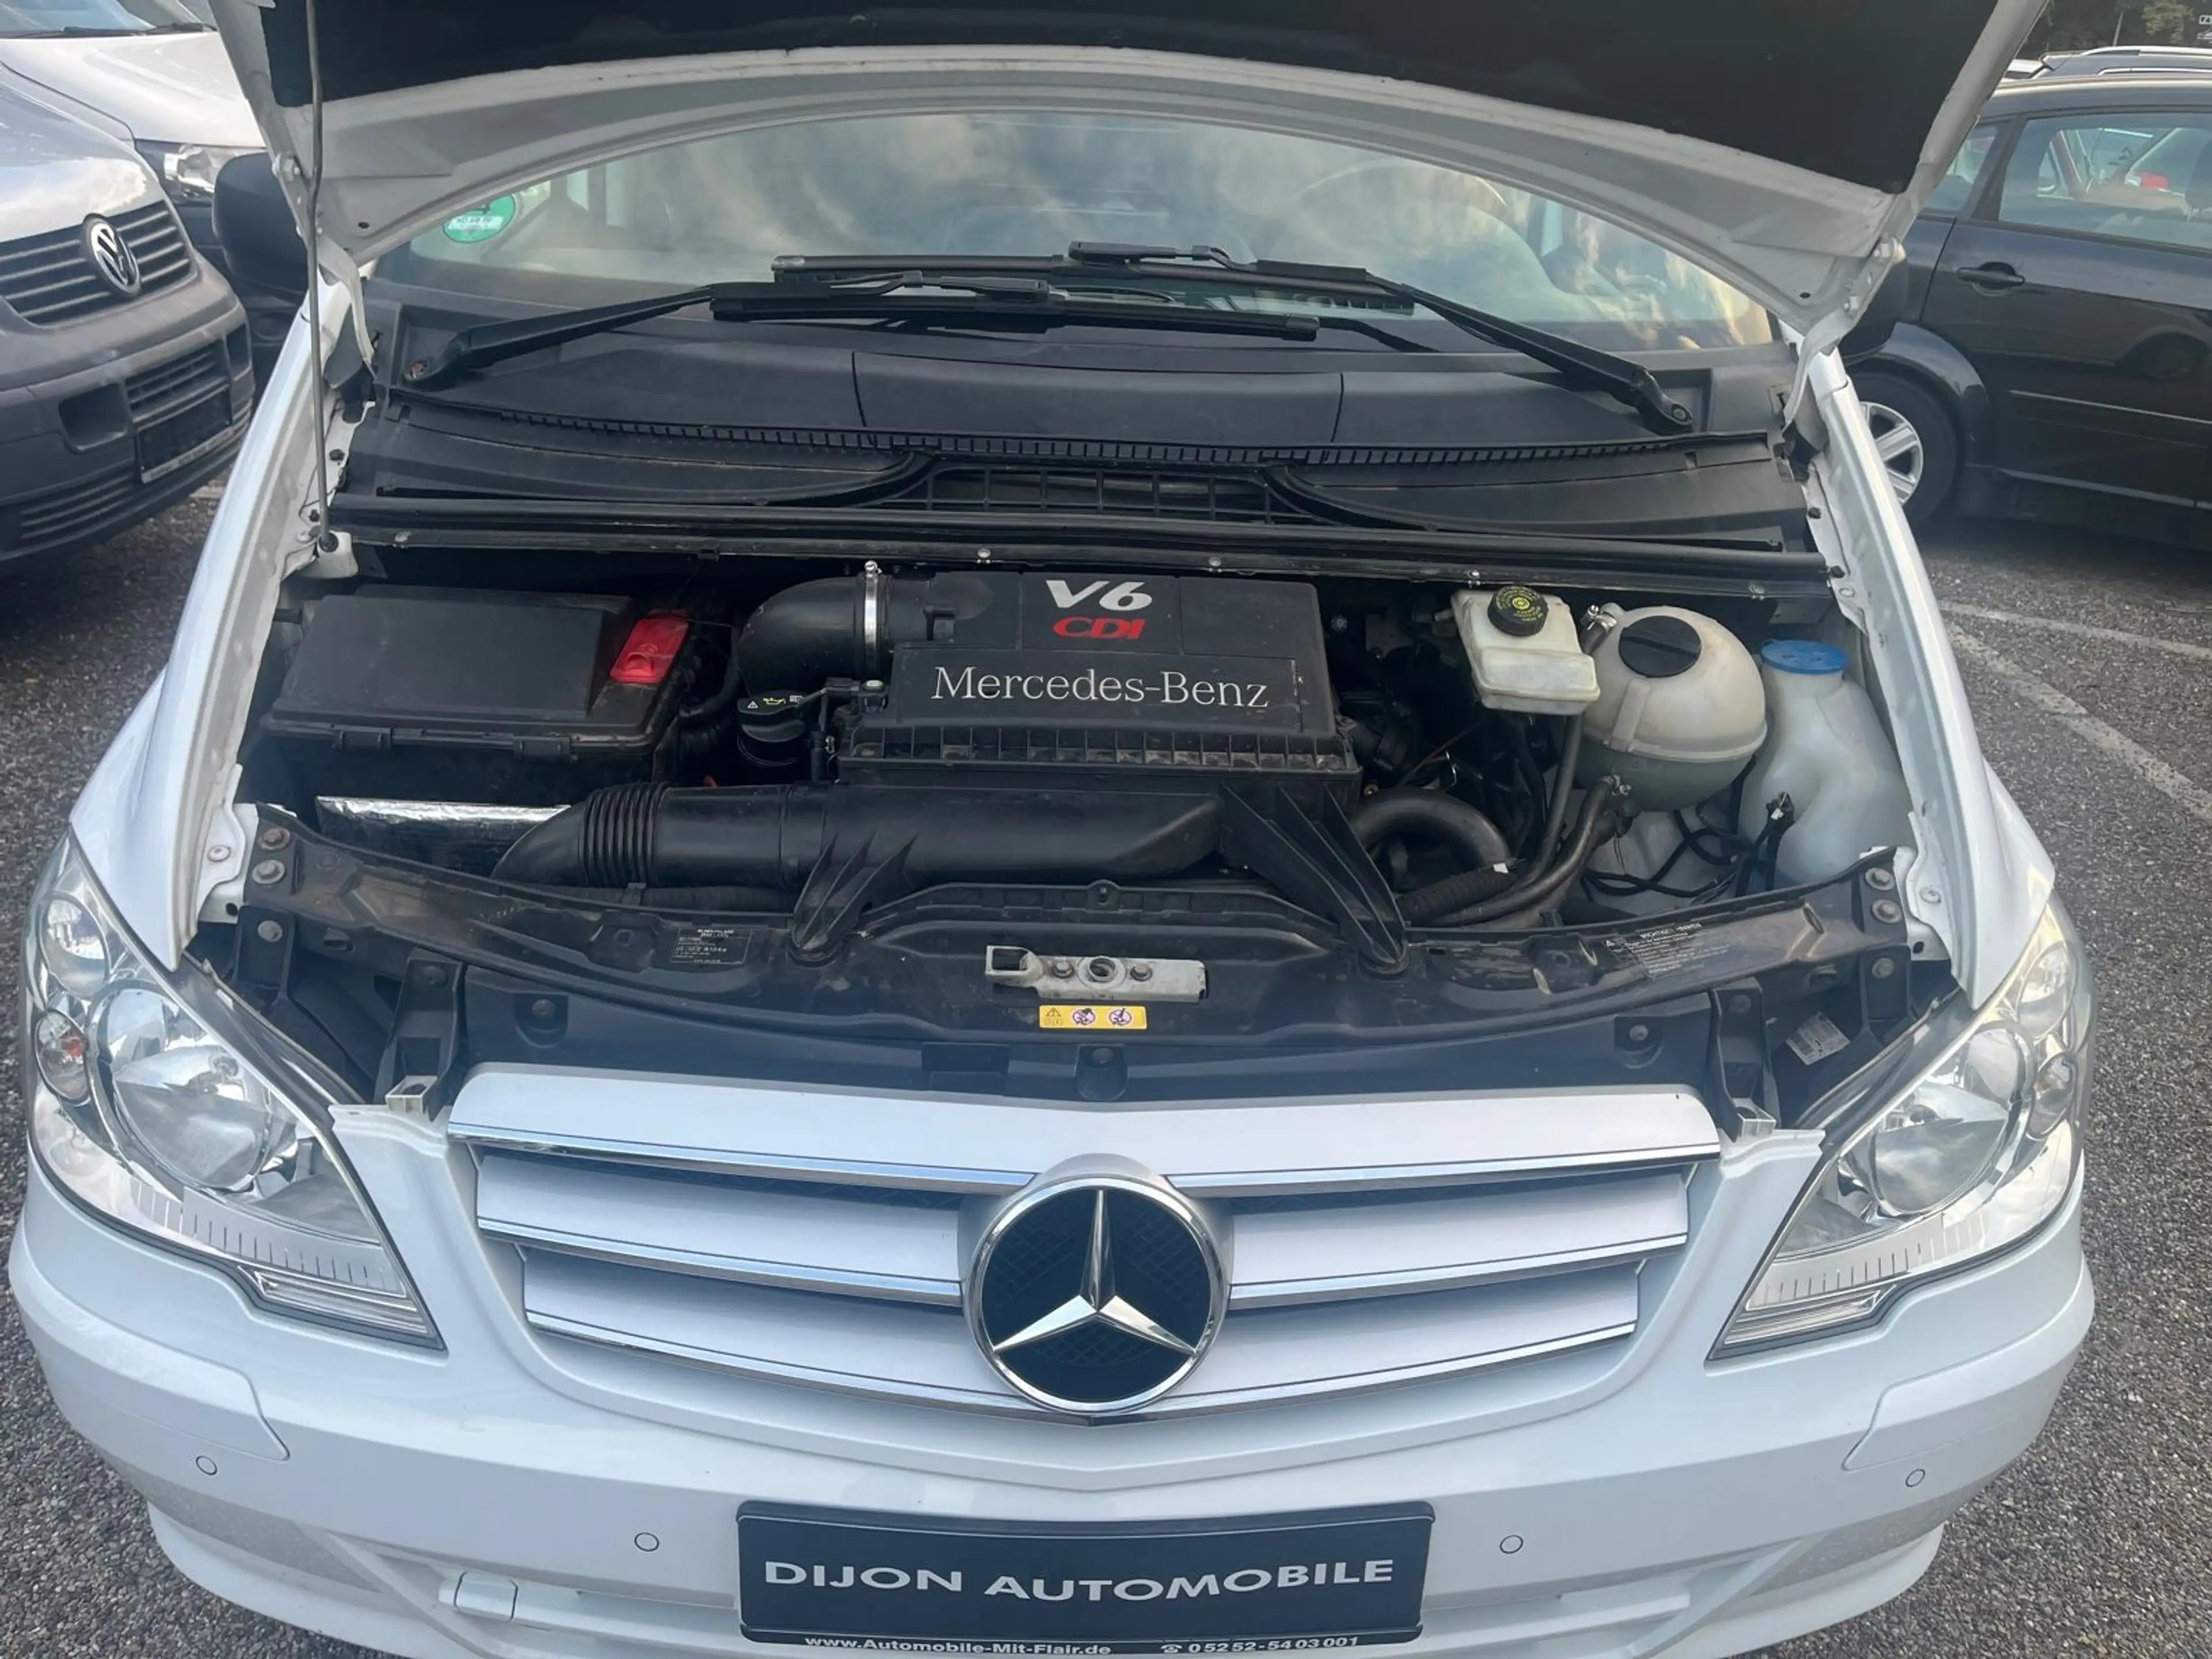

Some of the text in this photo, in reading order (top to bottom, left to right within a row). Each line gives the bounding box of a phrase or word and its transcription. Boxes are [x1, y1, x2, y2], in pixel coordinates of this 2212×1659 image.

[1046, 579, 1153, 611] V6
[1052, 616, 1146, 639] CDI
[930, 666, 1269, 708] Mercedes-Benz
[765, 1559, 1393, 1601] DIJON AUTOMOBILE
[804, 1637, 1112, 1655] www.Automobile-Mit-Flair.de
